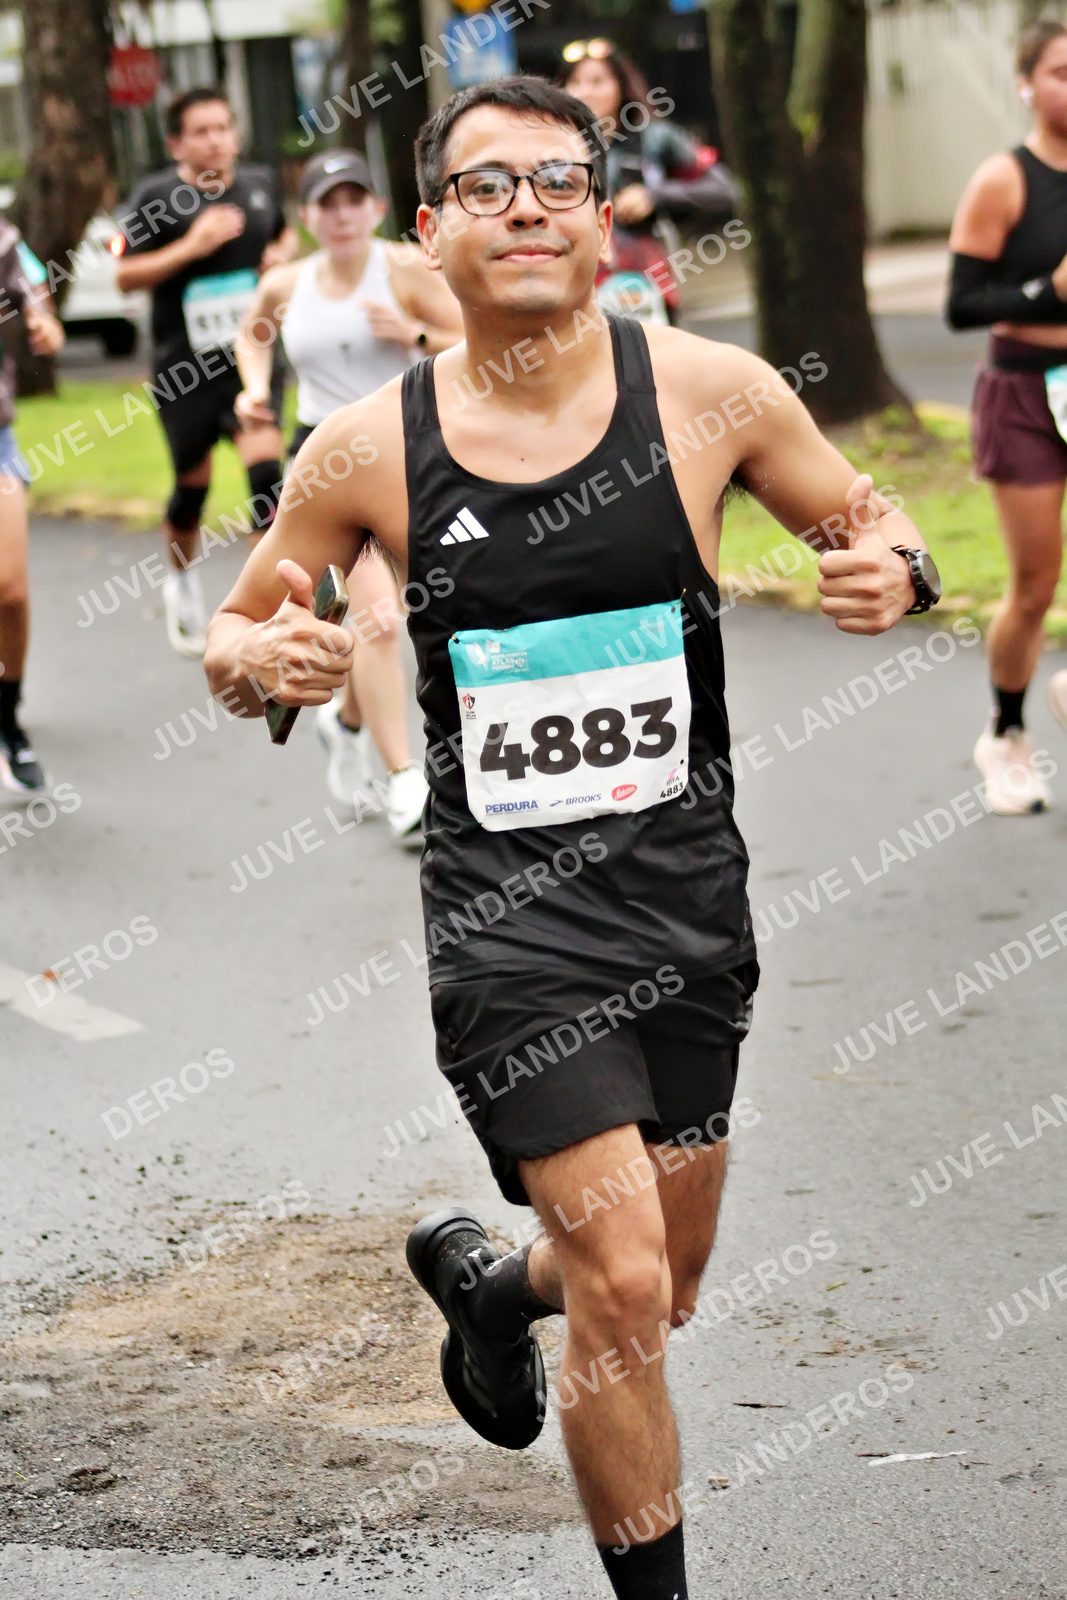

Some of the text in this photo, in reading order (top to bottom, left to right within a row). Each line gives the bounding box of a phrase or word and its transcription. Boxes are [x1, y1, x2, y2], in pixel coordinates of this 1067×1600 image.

[480, 697, 677, 780] 4883
[660, 781, 684, 799] 4883
[485, 800, 539, 813] PERDURA
[565, 794, 602, 806] BROOKS
